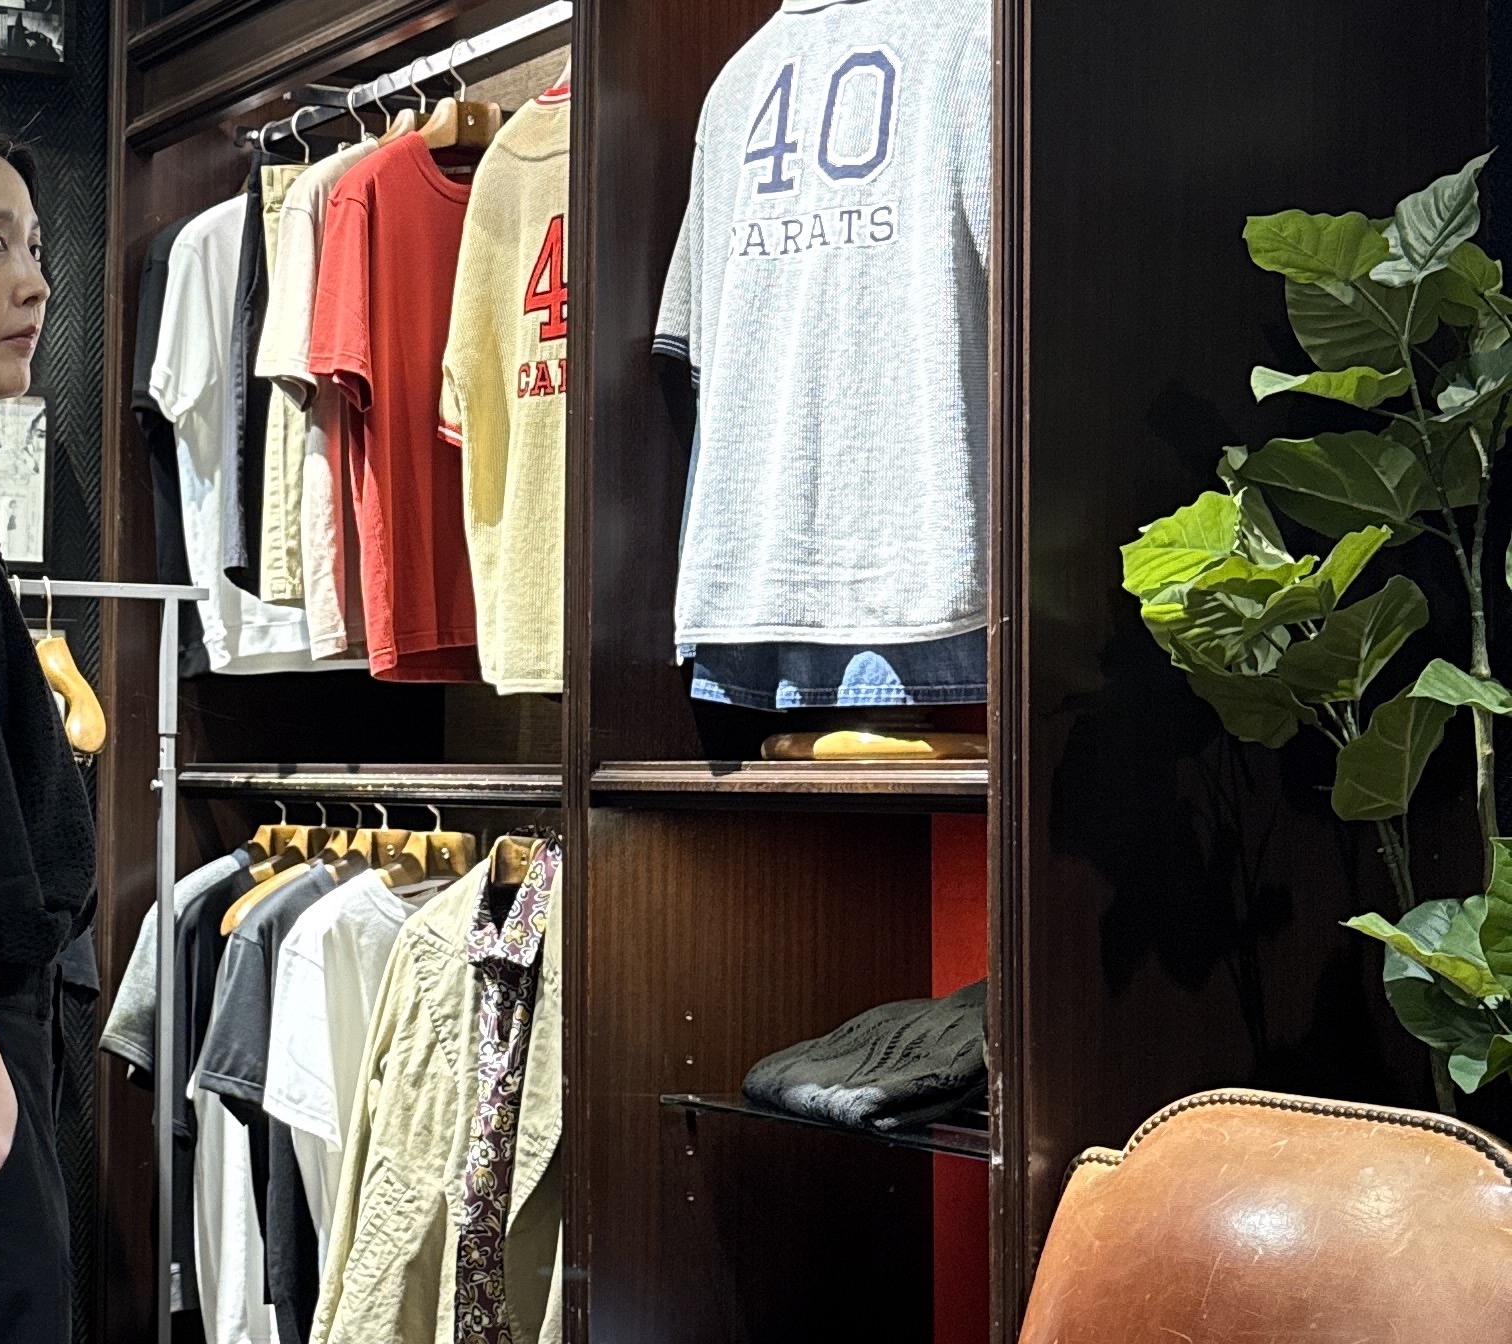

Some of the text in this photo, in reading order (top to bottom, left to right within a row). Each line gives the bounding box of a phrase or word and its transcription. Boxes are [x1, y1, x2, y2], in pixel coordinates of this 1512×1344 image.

[743, 49, 898, 195] 40
[523, 213, 568, 343] 4
[730, 205, 894, 257] ARATS
